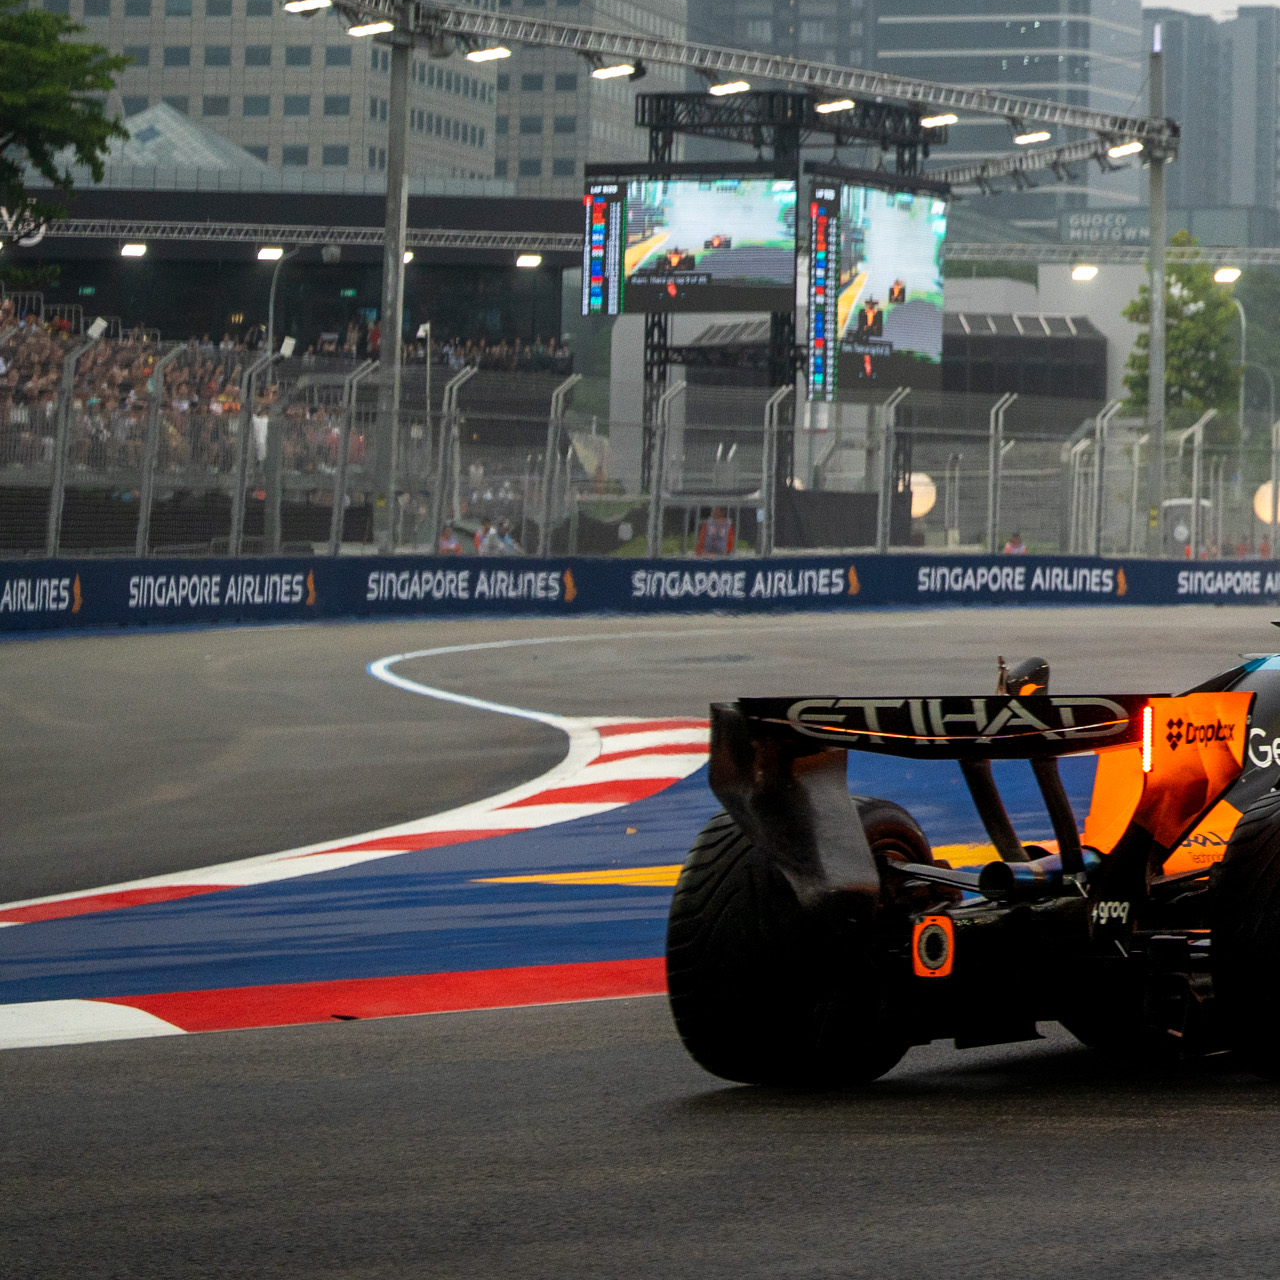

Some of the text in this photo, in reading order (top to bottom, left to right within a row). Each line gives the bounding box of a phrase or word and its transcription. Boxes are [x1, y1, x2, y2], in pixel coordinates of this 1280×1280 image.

[1069, 214, 1127, 228] GUOCO
[1069, 227, 1150, 241] MIDTOWN
[129, 573, 304, 608] SINGAPORE AIRLINES
[366, 570, 562, 601] SINGAPORE AIRLINES
[632, 569, 845, 598] SINGAPORE AIRLINES
[918, 566, 1114, 593] SINGAPORE AIRLINES
[1177, 570, 1261, 594] SINGAPORE
[0, 578, 70, 613] AIRLINES
[786, 697, 1130, 745] ETIHAD
[1185, 718, 1236, 747] Dropbox
[1098, 901, 1131, 924] groq
